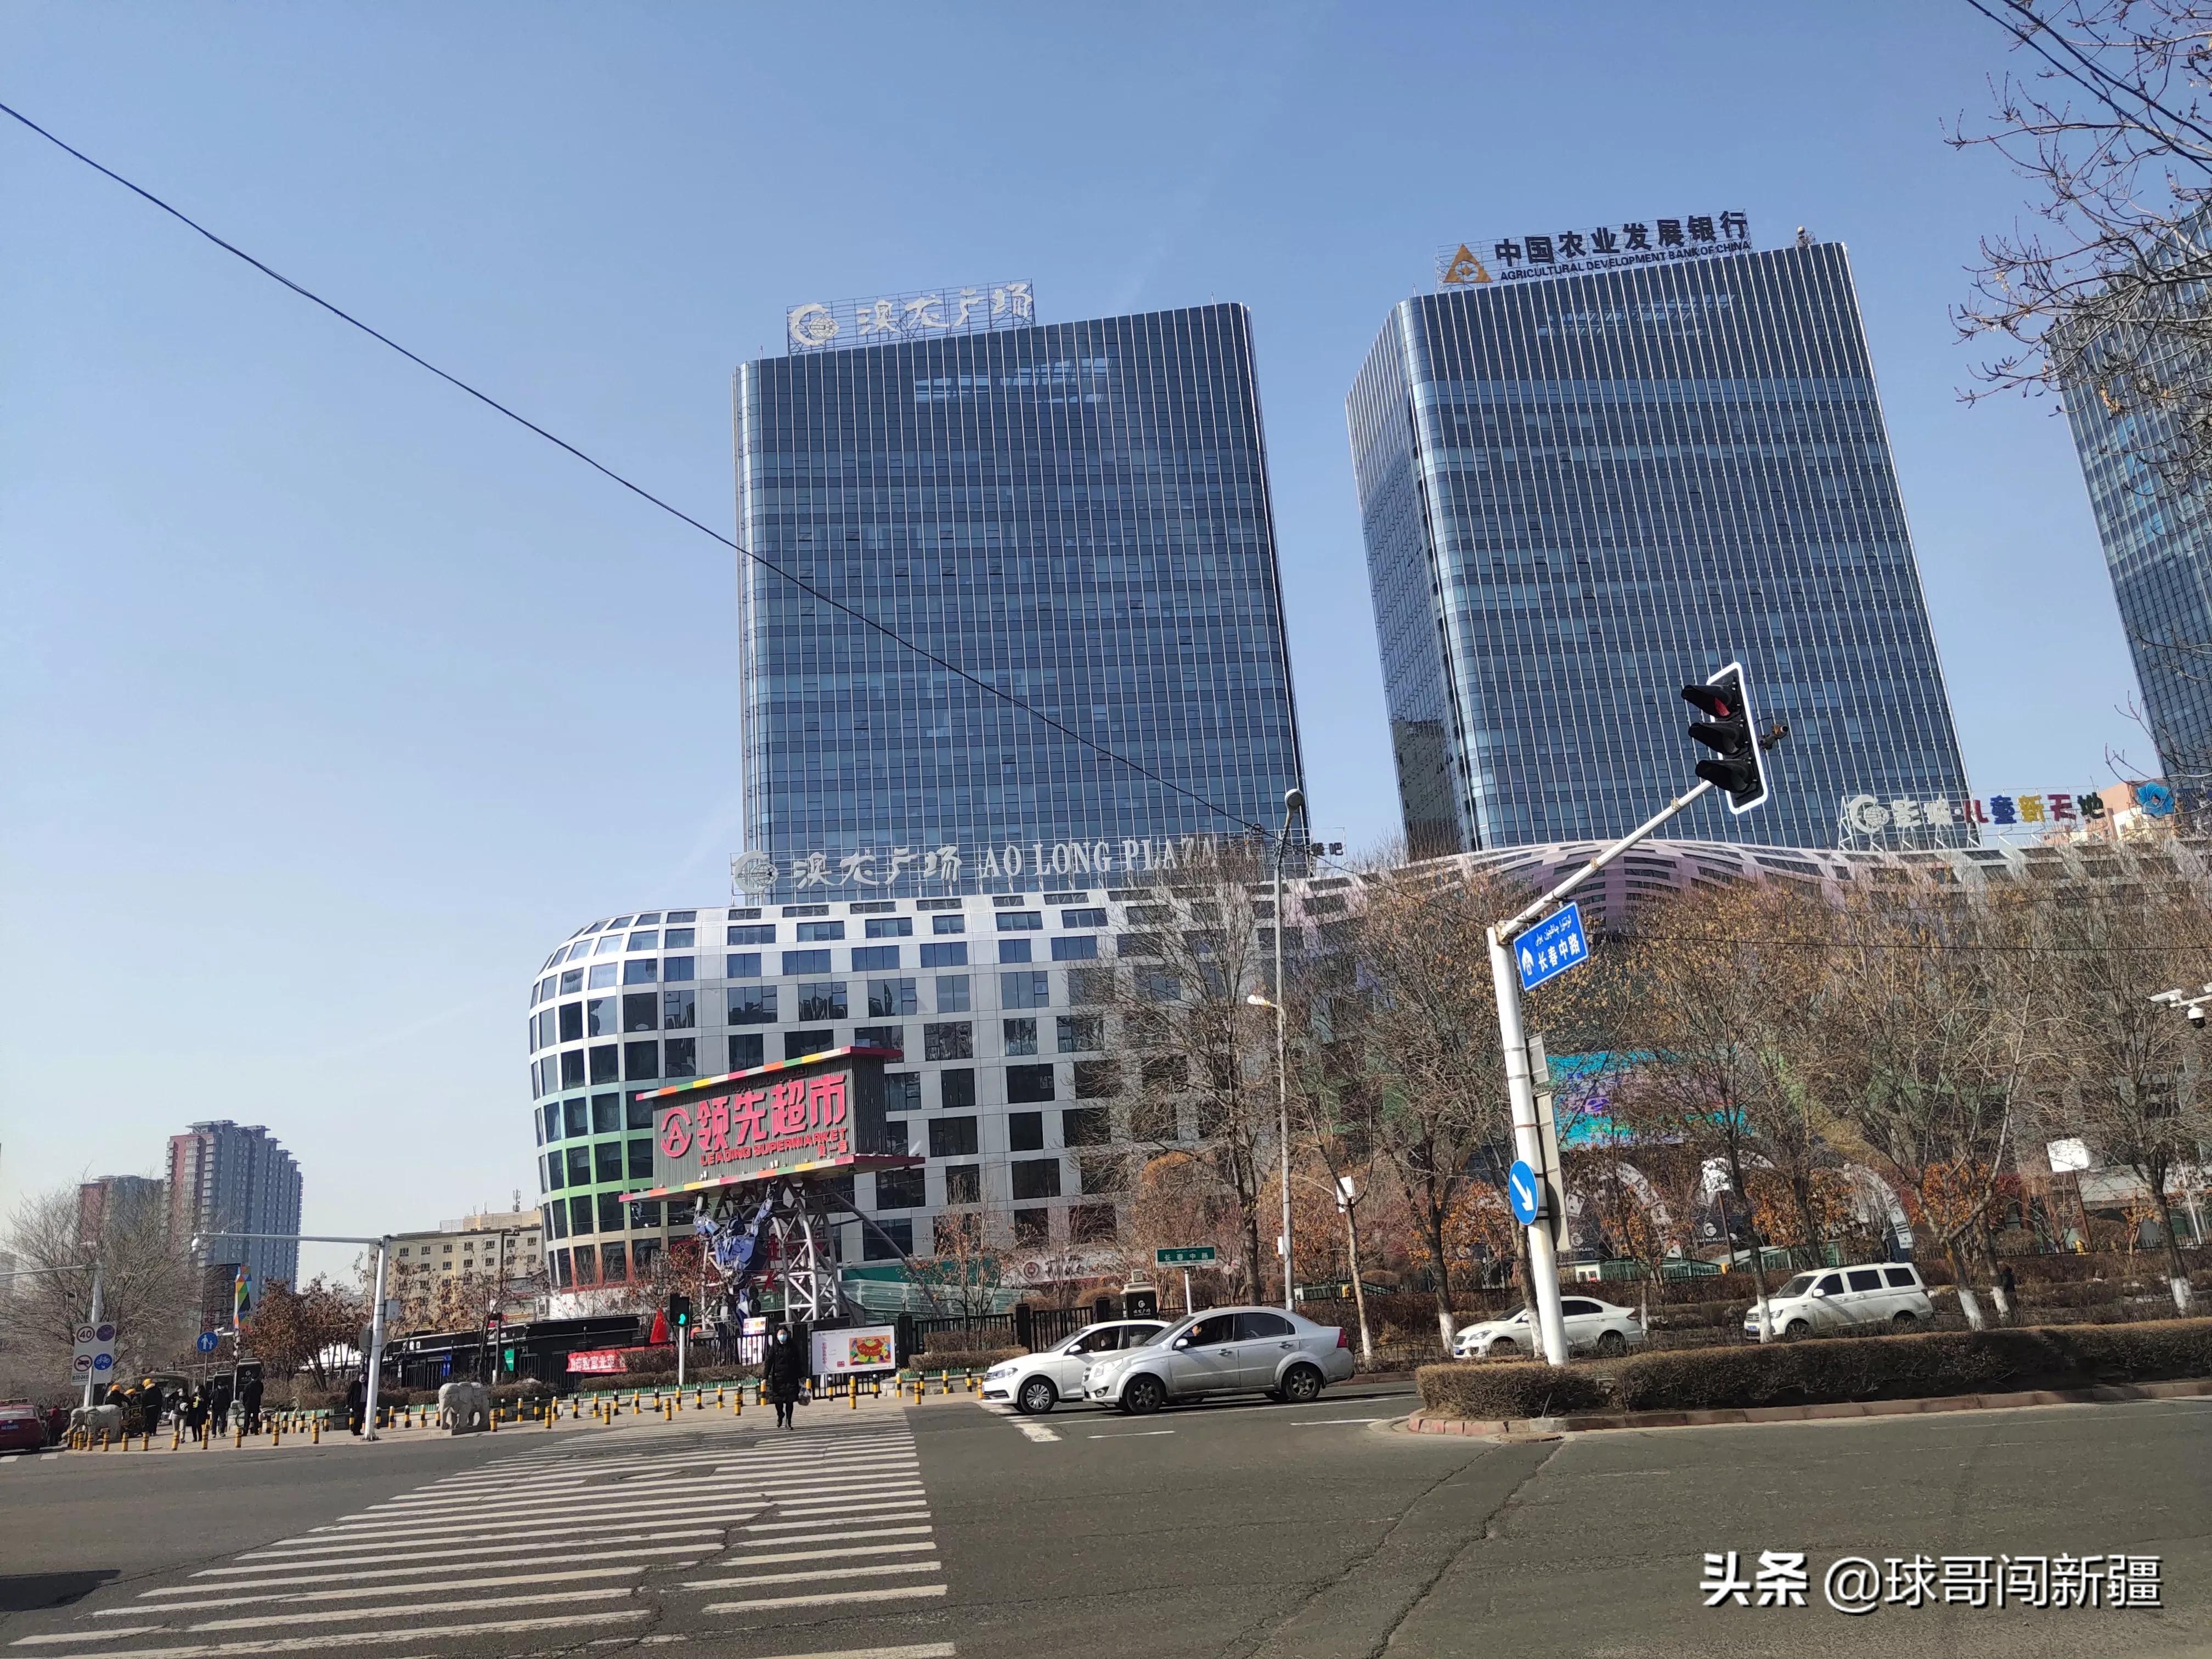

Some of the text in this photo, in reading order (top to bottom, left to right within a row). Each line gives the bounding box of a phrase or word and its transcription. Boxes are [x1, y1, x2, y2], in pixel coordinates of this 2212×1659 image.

[1495, 211, 1748, 267] 中国农业发展银行
[1500, 240, 1751, 281] AGRICULTURAL DEVELOPMENT BANK OF CHINA
[857, 283, 1032, 335] 澳龙广场
[794, 846, 963, 889] 澳龙广场
[983, 845, 1022, 878] AO
[1032, 842, 1113, 876] LONG
[1538, 932, 1581, 973] 长春中路
[697, 1073, 846, 1153] 领先超市
[700, 1127, 848, 1166] LEADING SUPERMARKET
[1164, 1252, 1209, 1261] 长春中路
[79, 1330, 92, 1339] 40
